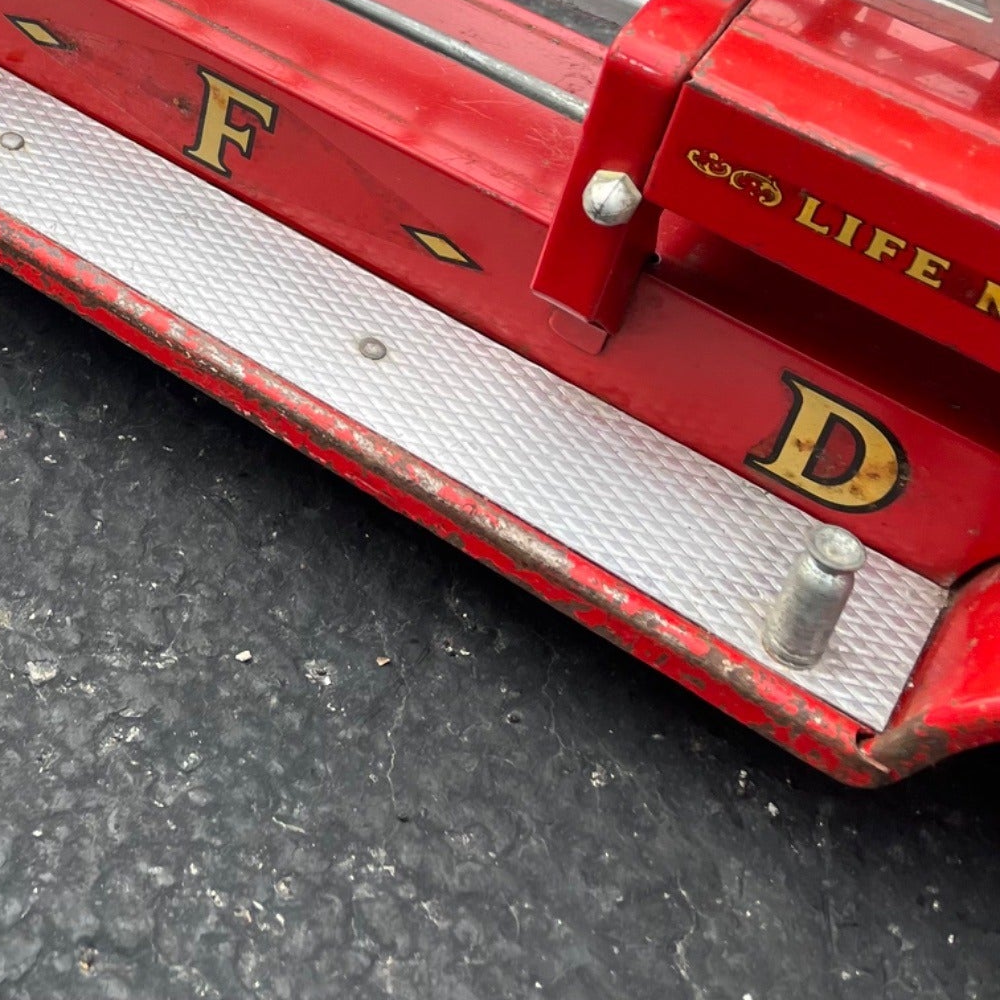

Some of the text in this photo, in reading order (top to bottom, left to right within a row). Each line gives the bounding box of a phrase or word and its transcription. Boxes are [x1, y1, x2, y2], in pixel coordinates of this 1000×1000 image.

[183, 64, 279, 179] F
[743, 368, 909, 514] D
[795, 195, 951, 289] LIFE
